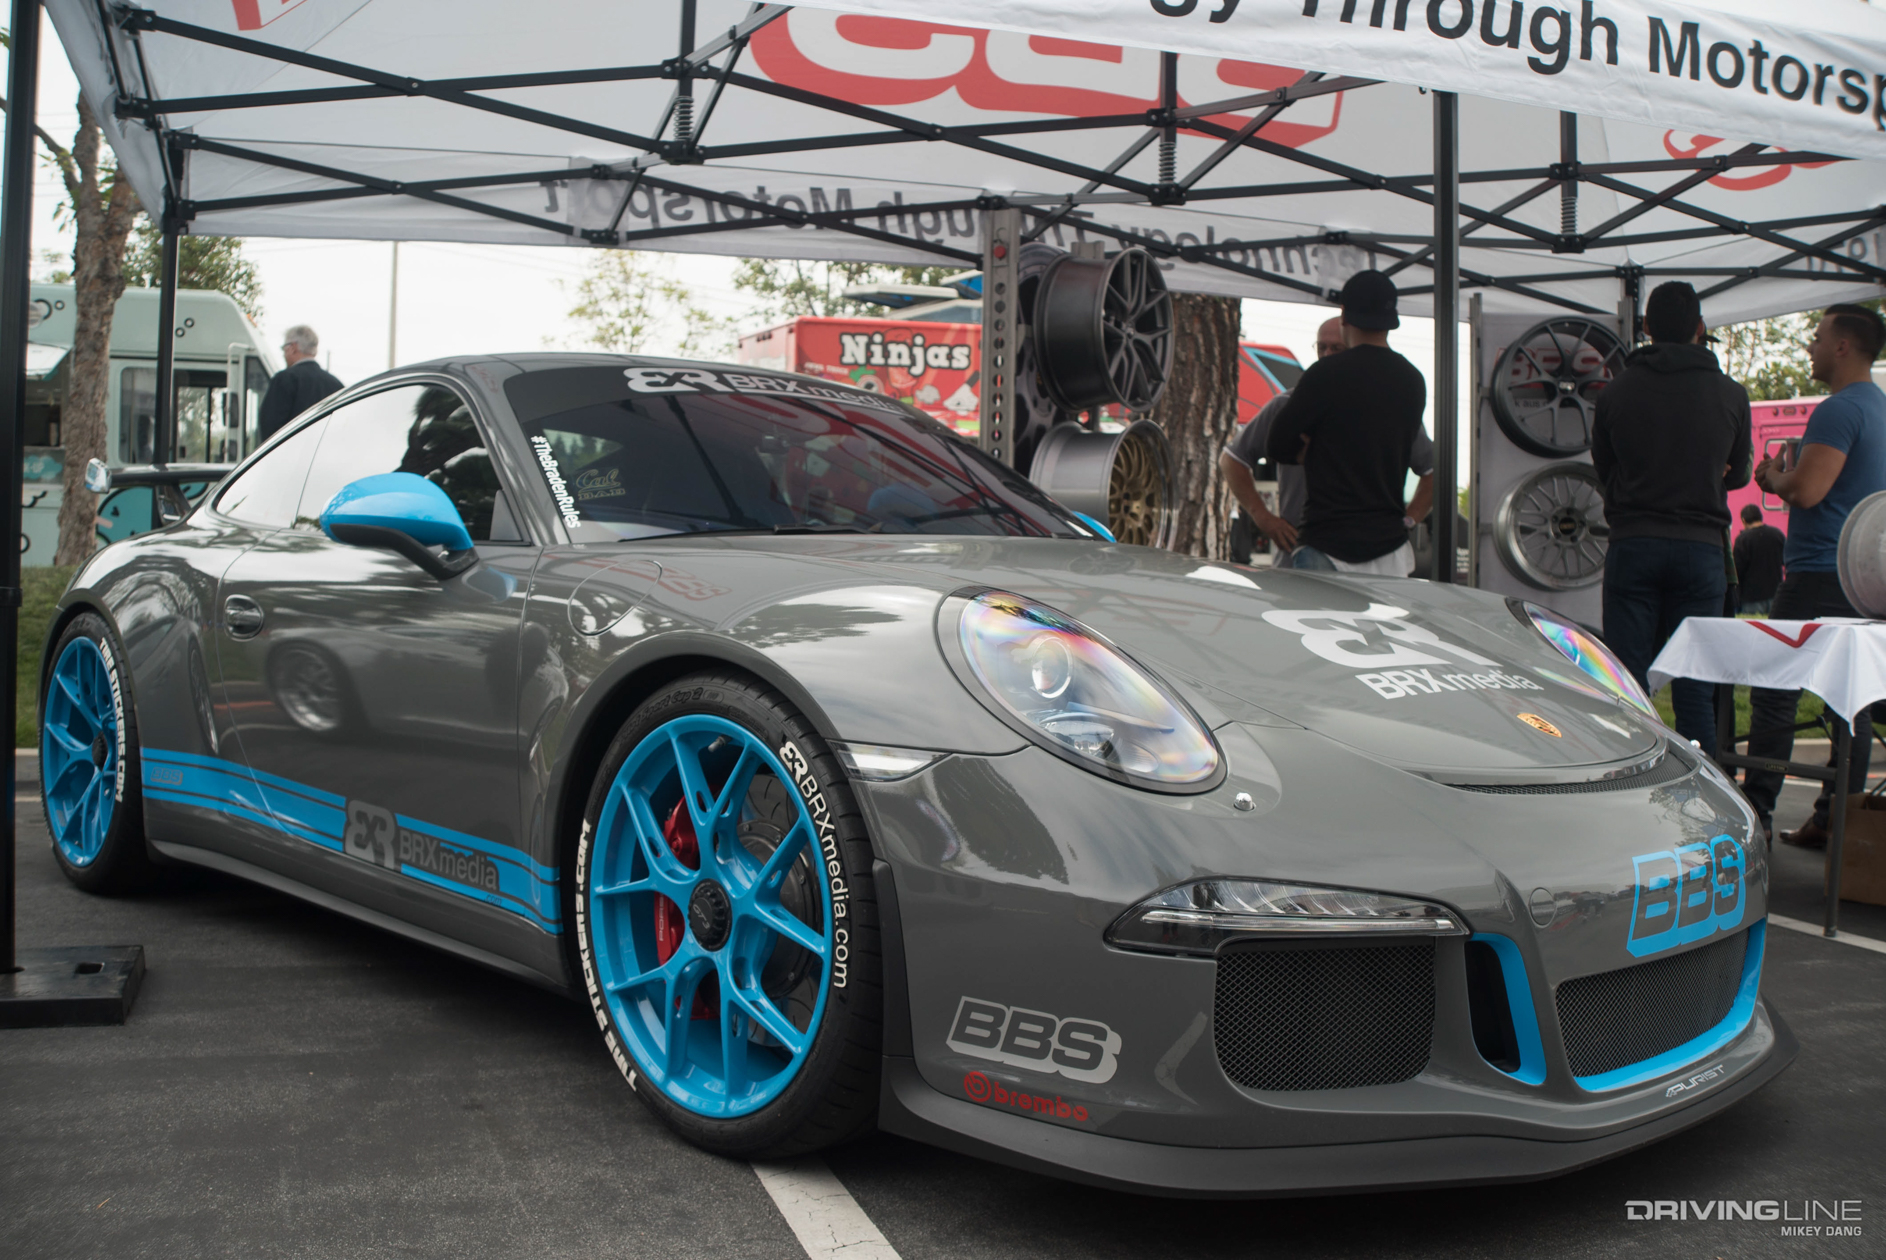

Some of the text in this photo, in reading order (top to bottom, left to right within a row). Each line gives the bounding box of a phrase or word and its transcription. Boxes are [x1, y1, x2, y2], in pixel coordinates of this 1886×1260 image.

[840, 332, 971, 376] Ninjas
[531, 436, 581, 528] #TheBradenRules
[576, 468, 621, 493] Cal
[578, 488, 625, 500] DAD
[692, 687, 704, 701] 2
[1355, 668, 1544, 699] BRXmedia
[400, 830, 498, 891] BRXmedia
[1626, 834, 1746, 958] BBS
[692, 903, 711, 930] GT3
[946, 995, 1122, 1084] BBS
[1665, 1064, 1725, 1098] PURIST
[994, 1081, 1089, 1122] brembo
